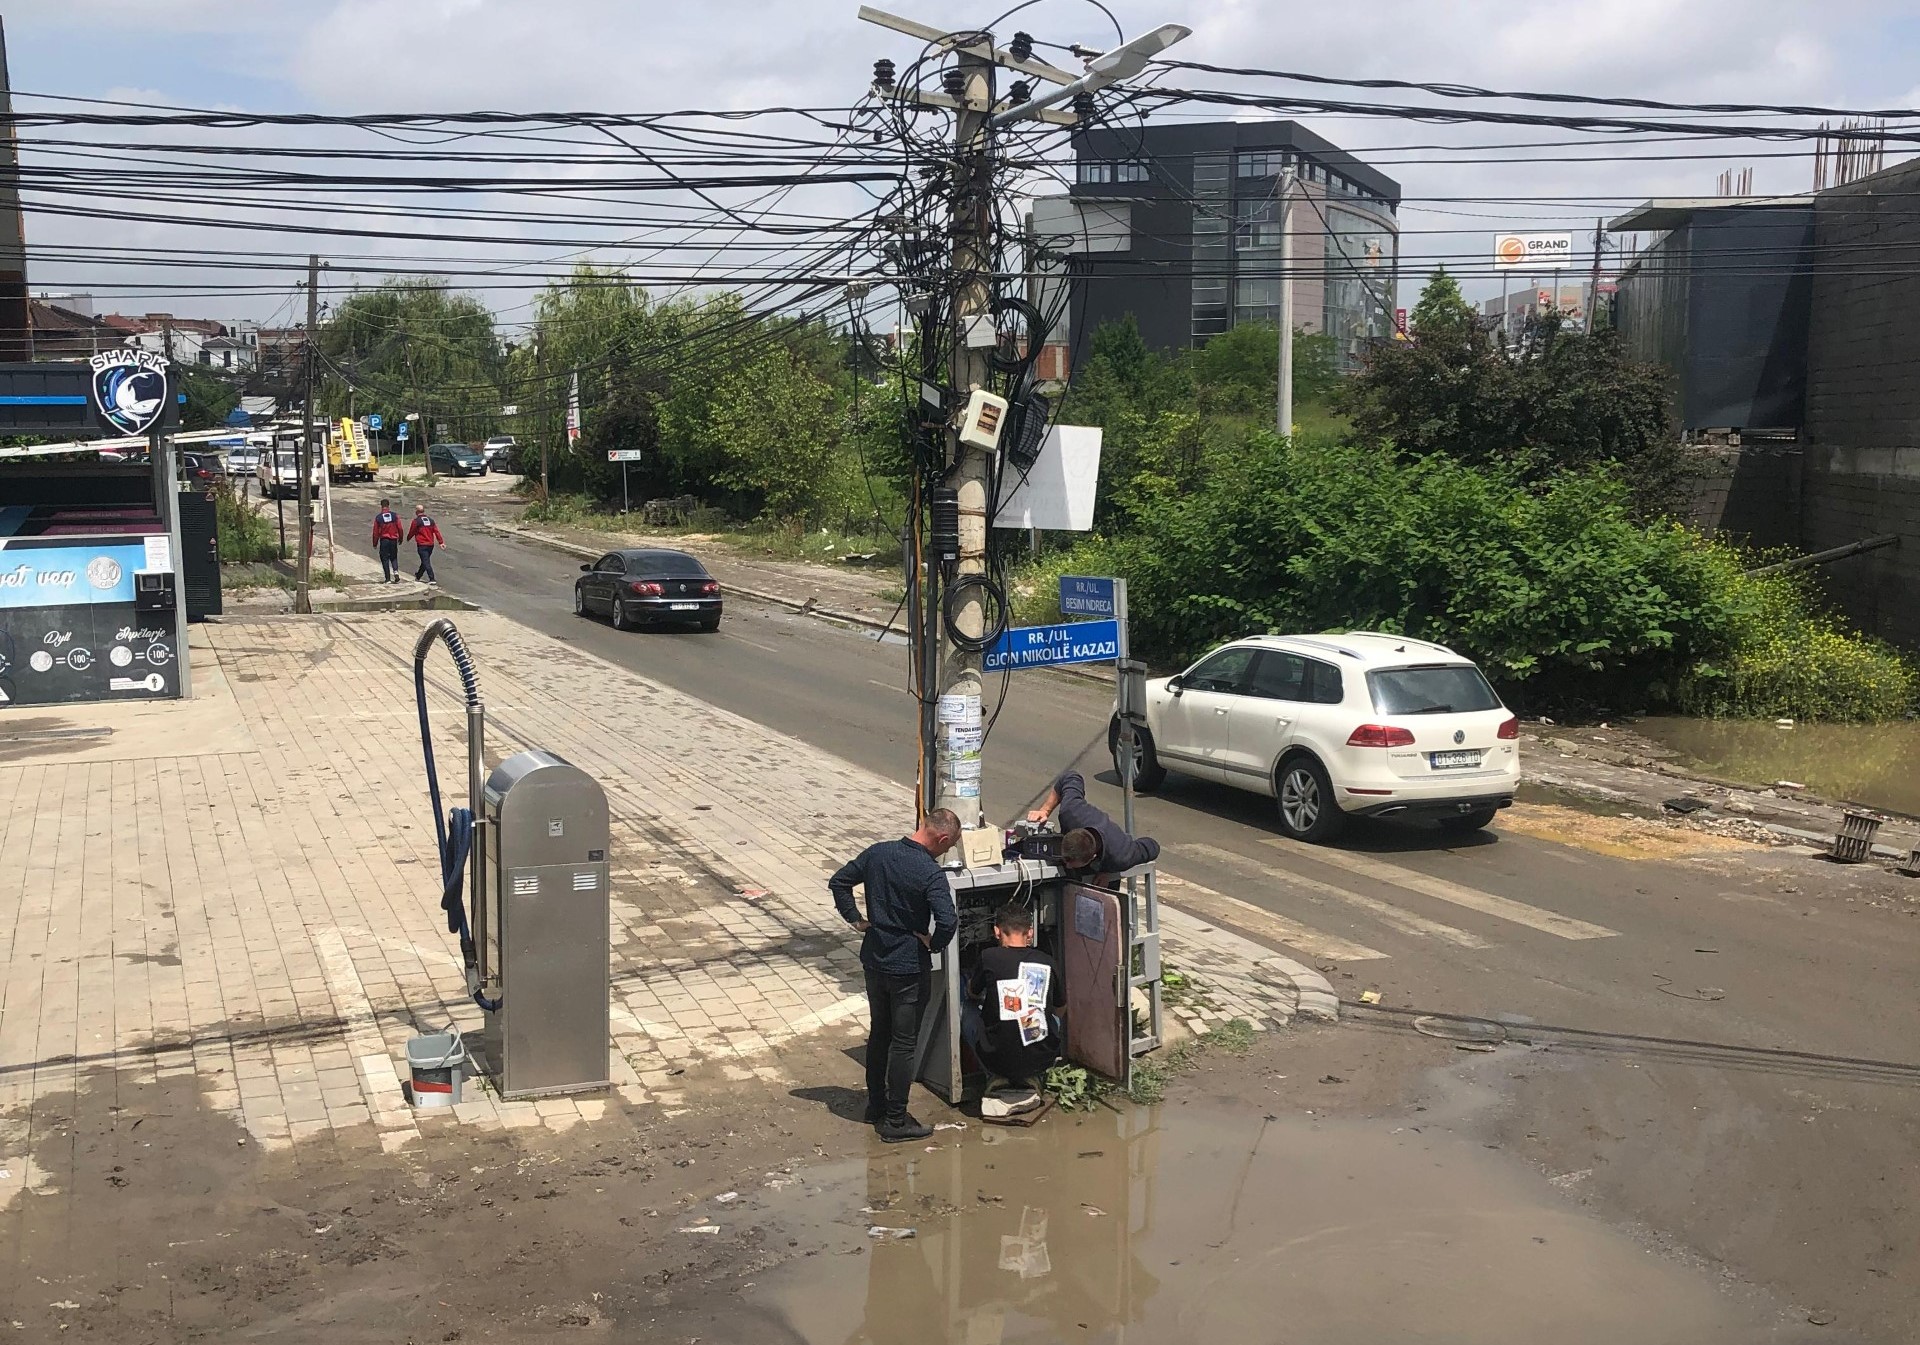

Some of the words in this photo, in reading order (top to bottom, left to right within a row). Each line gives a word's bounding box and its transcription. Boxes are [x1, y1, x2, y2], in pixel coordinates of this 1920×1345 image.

[1528, 239, 1569, 250] GRAND
[91, 350, 168, 373] SHARK
[371, 417, 379, 426] P
[1076, 581, 1100, 594] RR./UL.
[1086, 599, 1113, 612] NDRECA
[1028, 630, 1073, 645] RR./UL.
[73, 654, 86, 664] 100
[152, 650, 165, 659] 100
[986, 651, 1019, 667] GJON
[1022, 643, 1070, 663] NIKOLLË
[1073, 641, 1116, 658] KAZAZI
